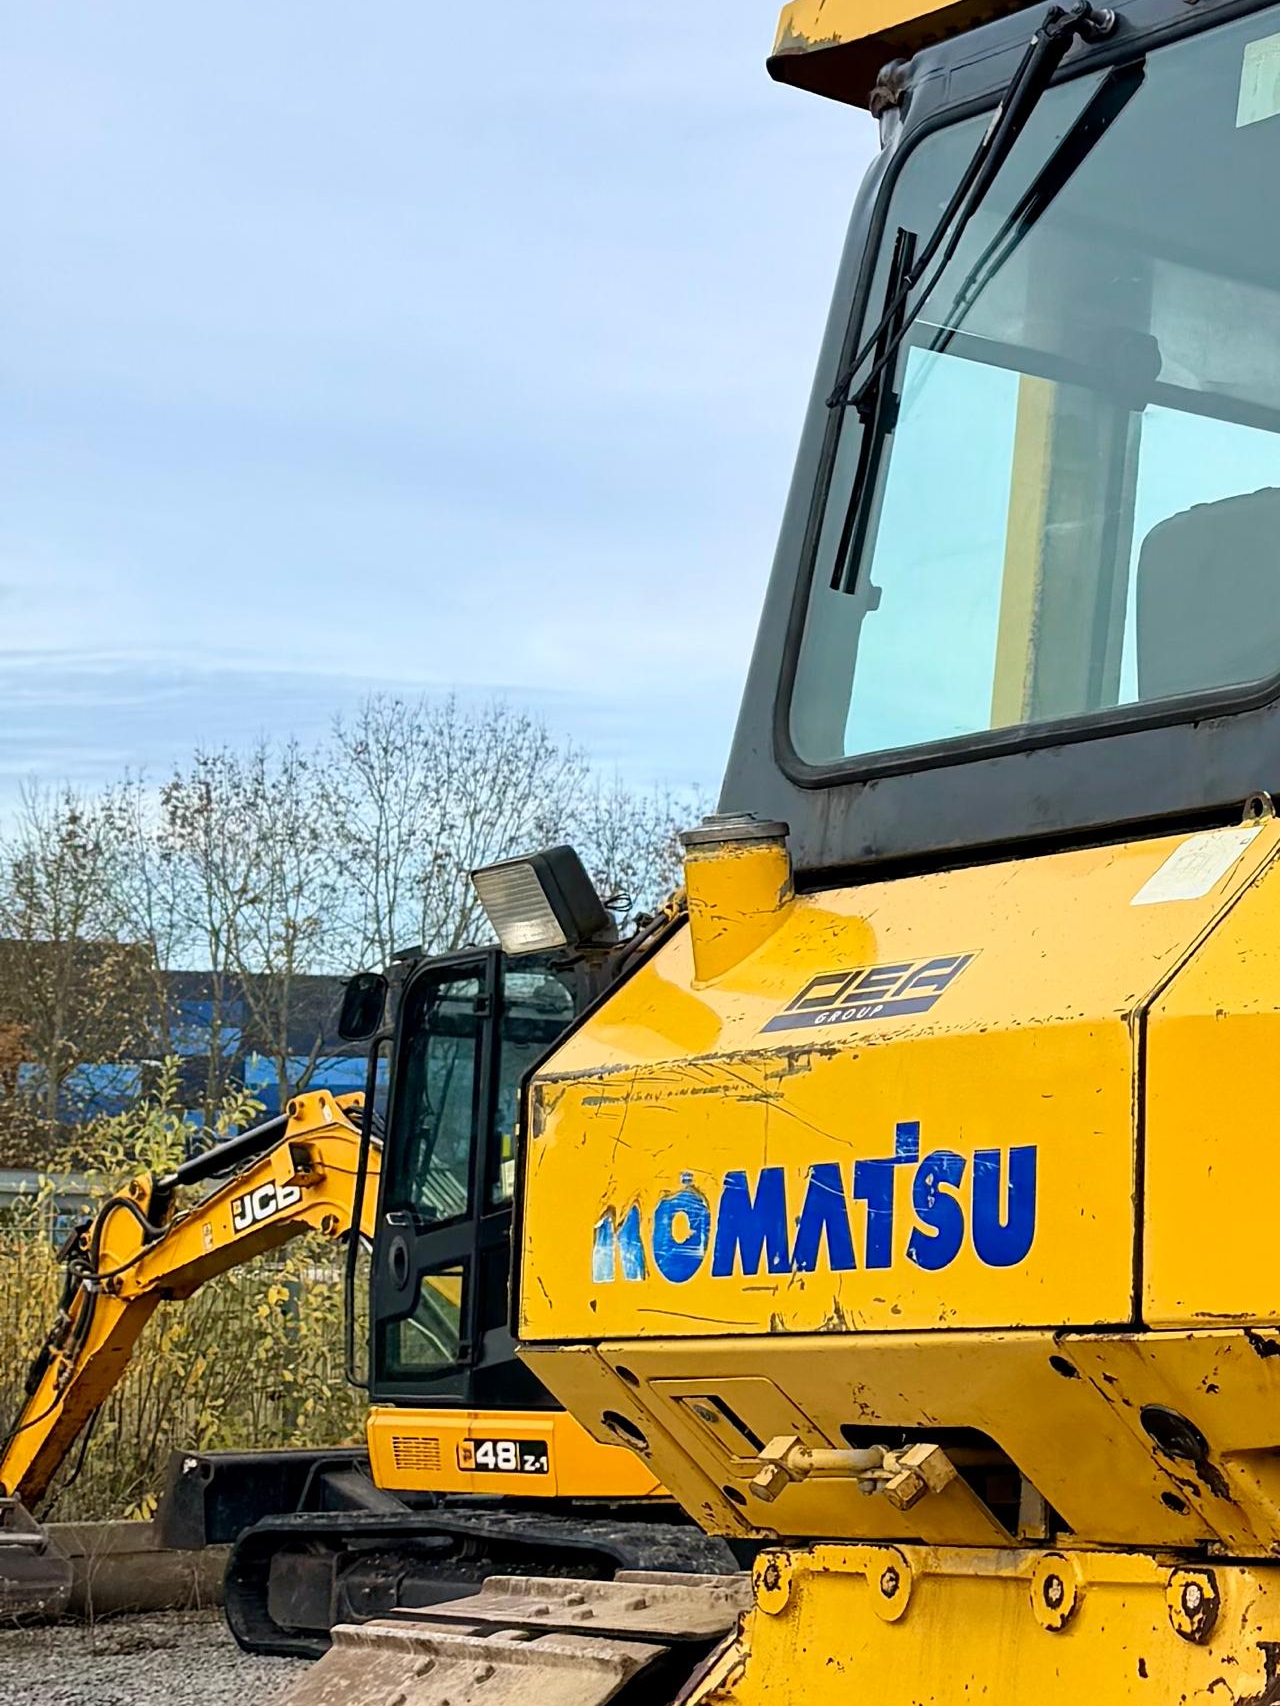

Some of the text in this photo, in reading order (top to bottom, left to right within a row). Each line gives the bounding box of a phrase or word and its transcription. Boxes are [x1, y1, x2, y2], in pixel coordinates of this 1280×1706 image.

[814, 1004, 884, 1025] GROUP
[232, 1183, 301, 1230] JCB
[591, 1121, 1038, 1284] KOMATSU
[476, 1441, 516, 1470] 48
